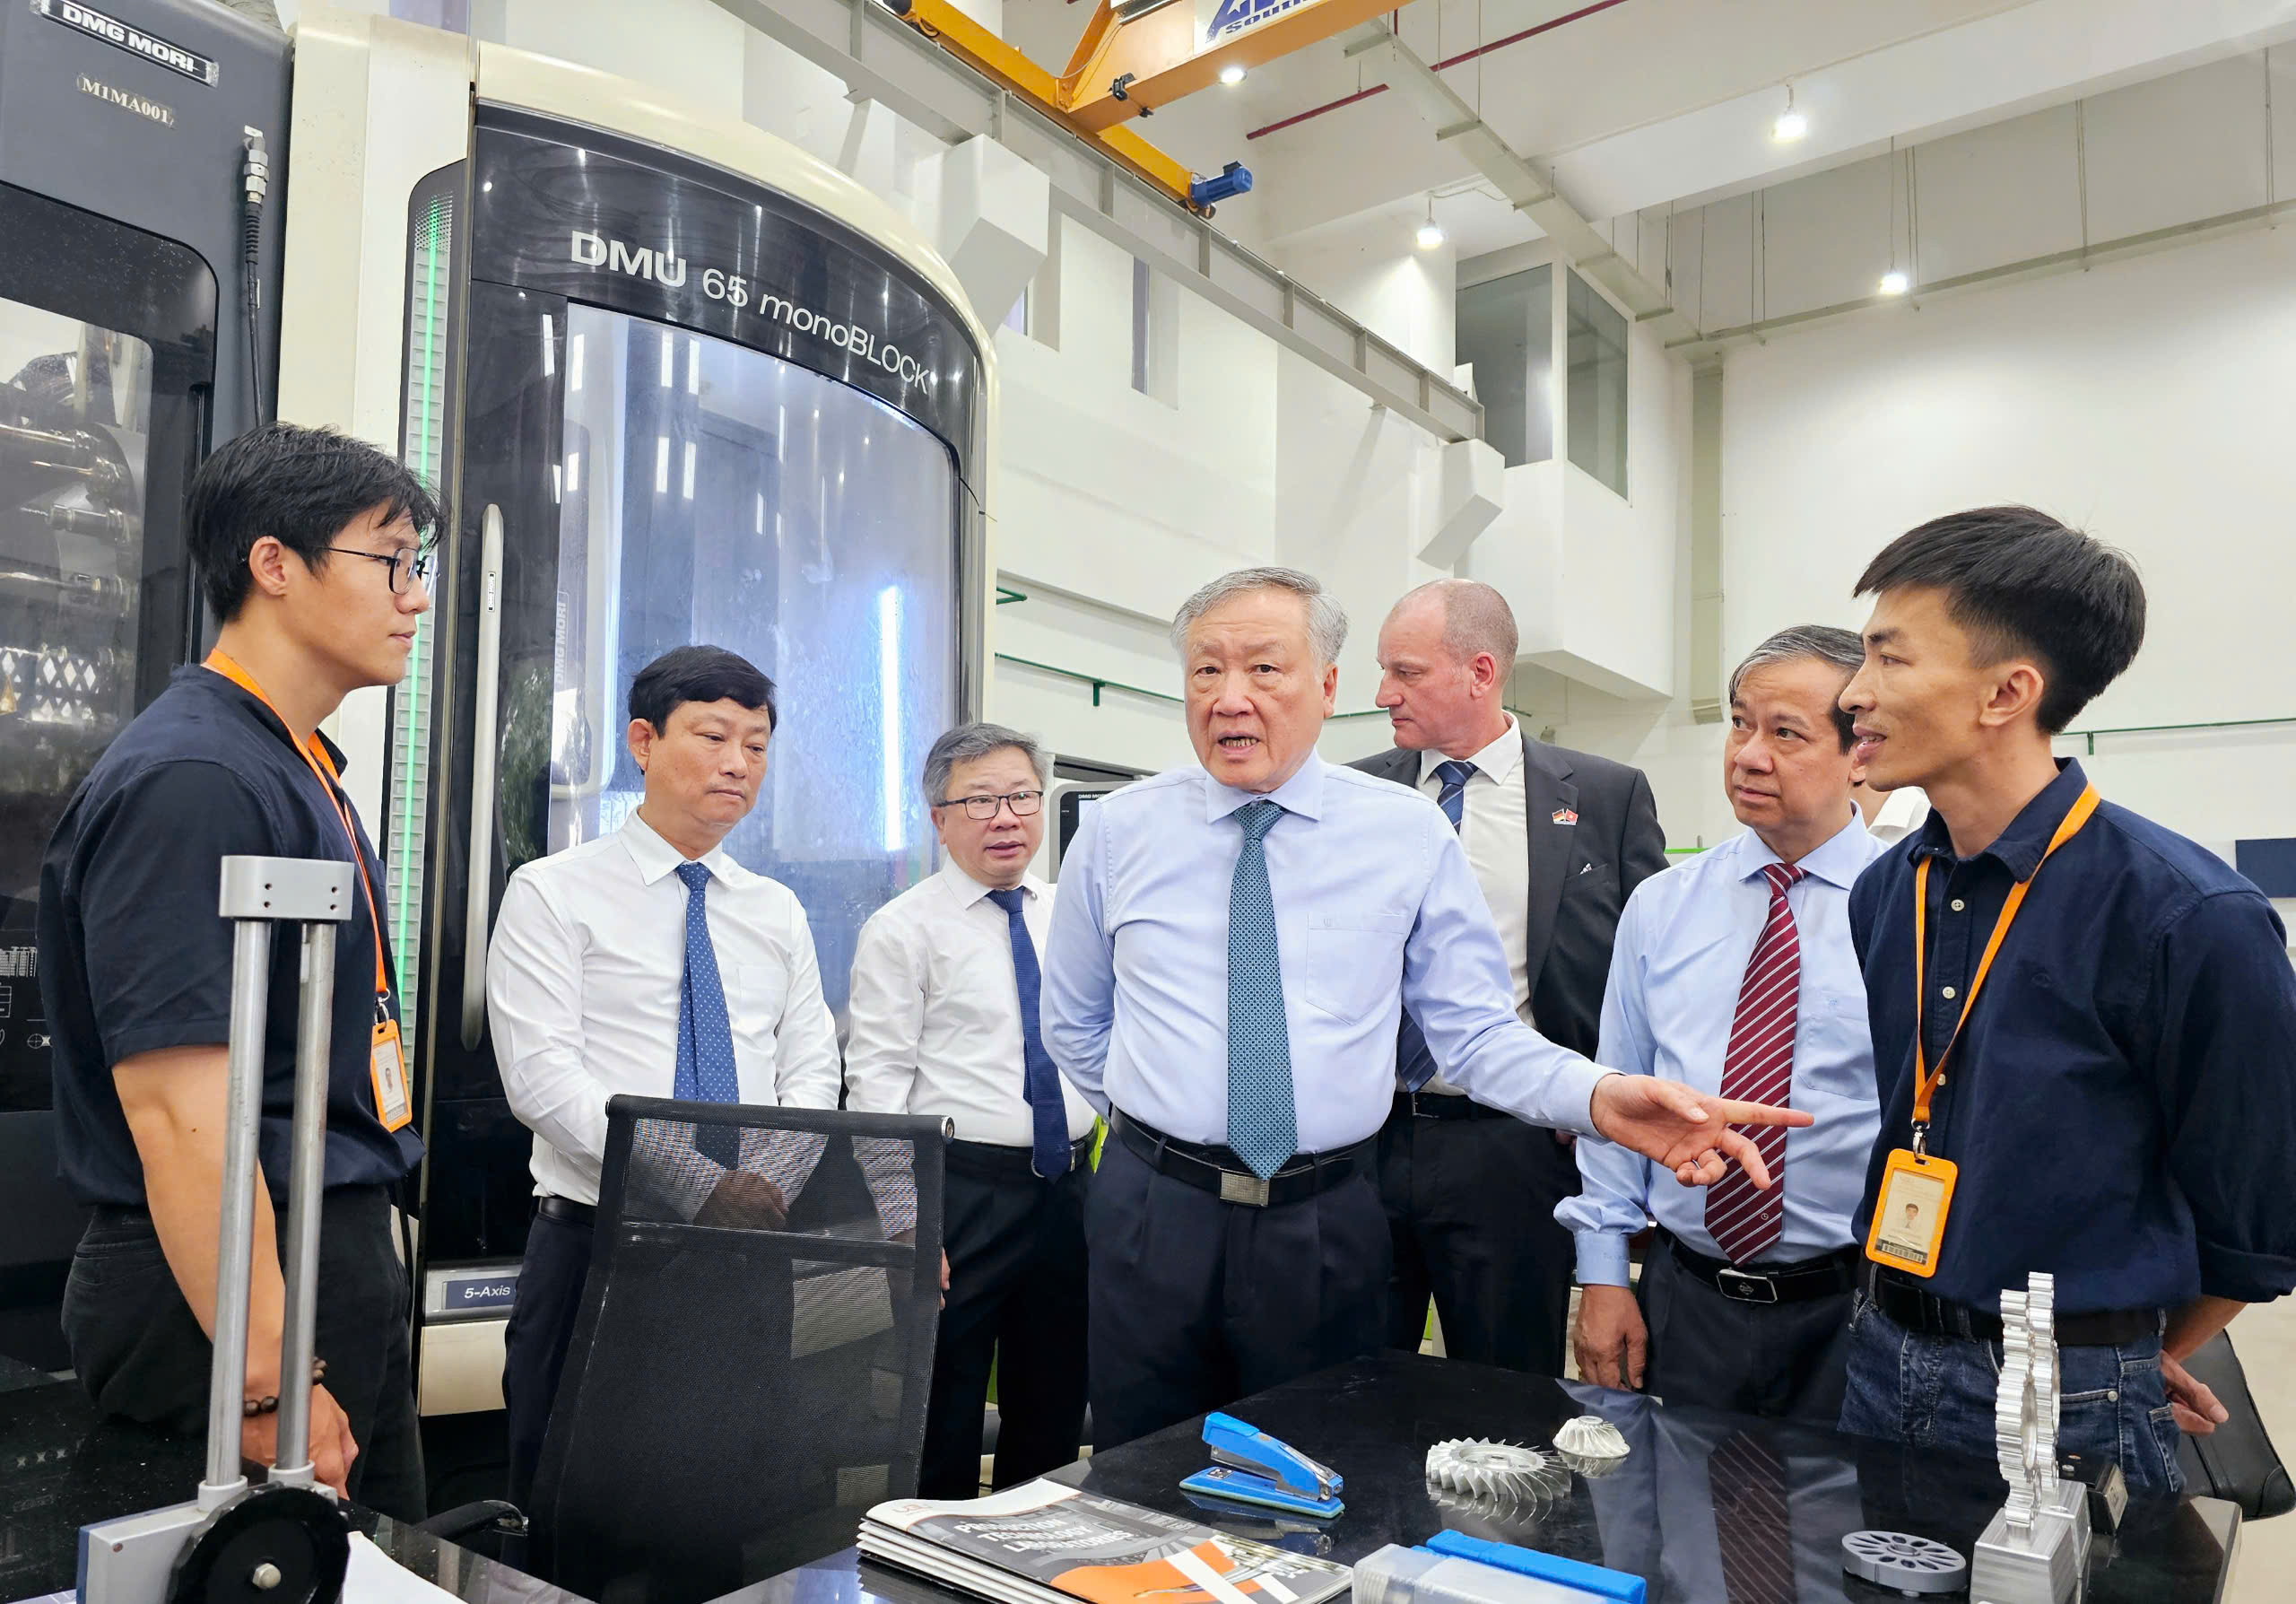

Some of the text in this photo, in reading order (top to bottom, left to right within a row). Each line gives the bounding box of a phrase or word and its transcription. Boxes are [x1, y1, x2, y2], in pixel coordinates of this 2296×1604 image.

[62, 3, 195, 73] DMG MORI
[83, 76, 170, 124] M1MA001
[570, 230, 933, 395] DMU 65 monoBLOCK
[464, 1285, 511, 1299] 5-Axis
